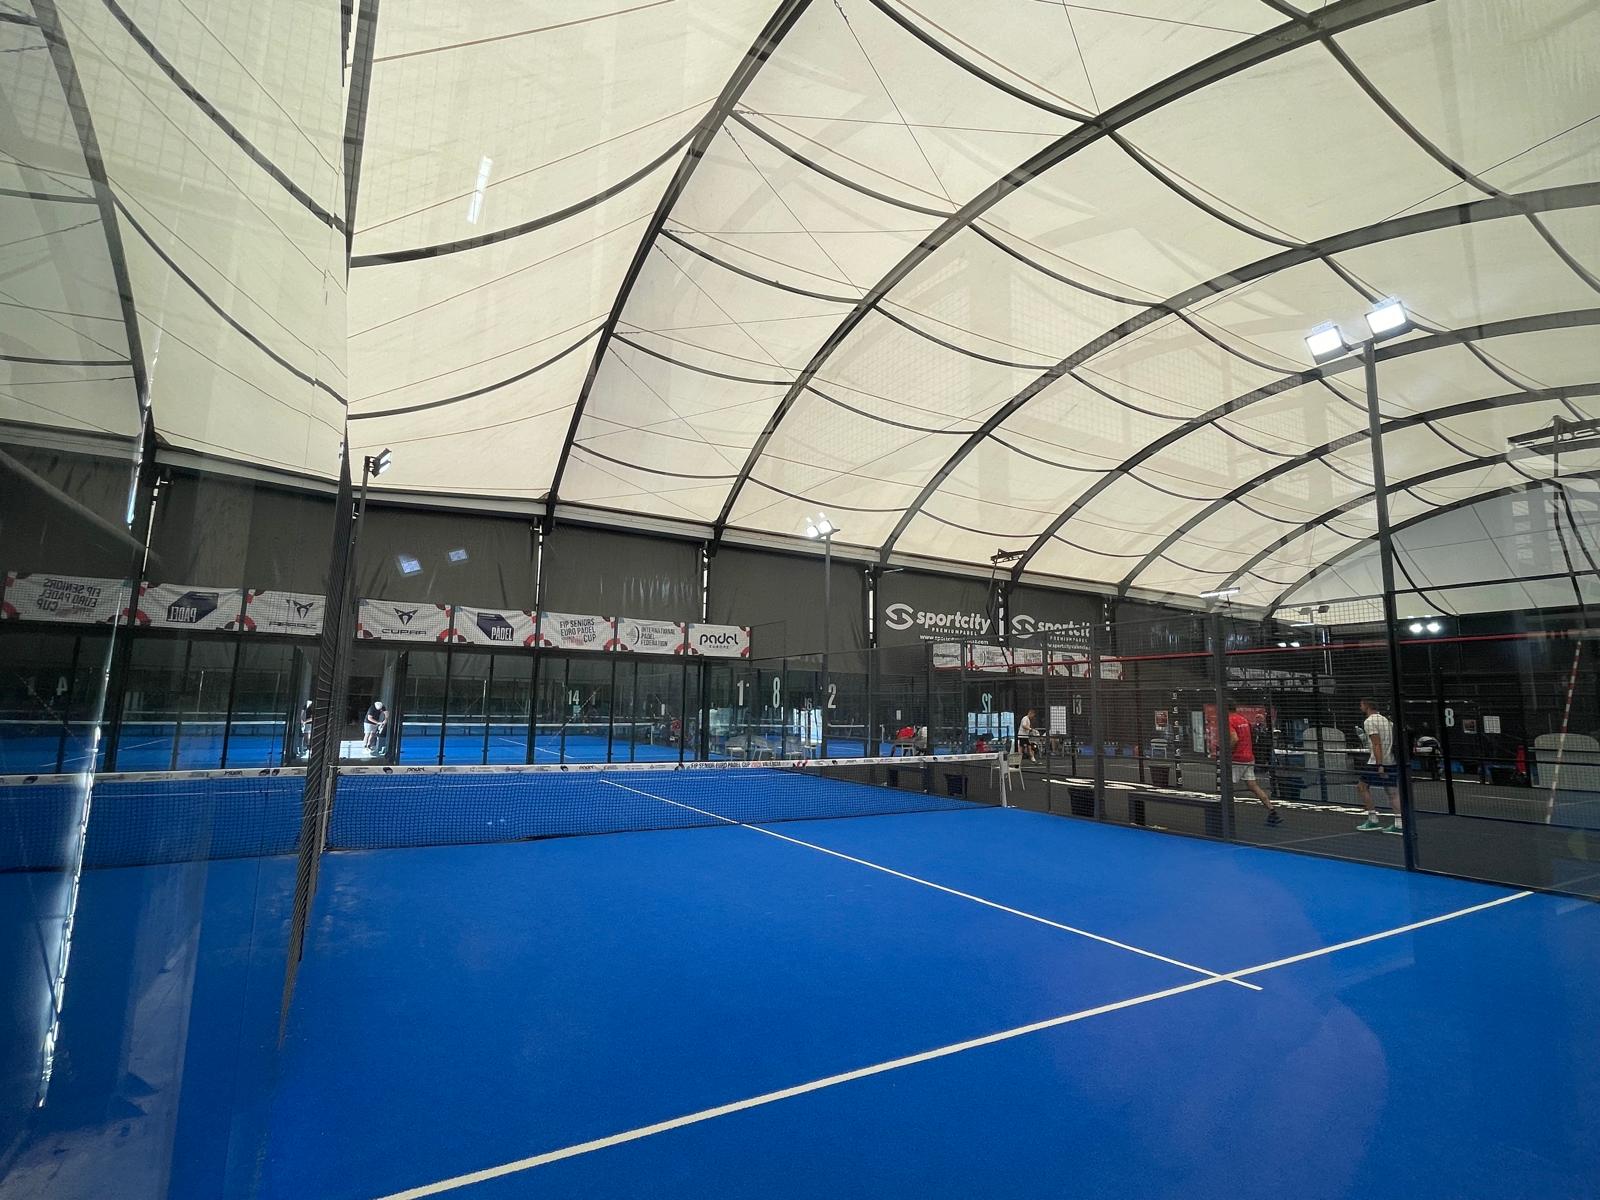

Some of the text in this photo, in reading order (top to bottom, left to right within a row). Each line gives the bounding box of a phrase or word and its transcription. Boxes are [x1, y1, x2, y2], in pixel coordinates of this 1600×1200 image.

[559, 617, 595, 629] FIP SENIORS
[916, 611, 991, 634] sportcity
[381, 628, 427, 636] CUPRA
[560, 625, 596, 637] EURO PADEL
[583, 633, 597, 643] CUP
[700, 633, 739, 646] padel
[568, 689, 580, 705] 14
[737, 680, 744, 706] 1
[773, 677, 781, 709] 8
[827, 683, 837, 709] 2
[1444, 707, 1455, 727] 8
